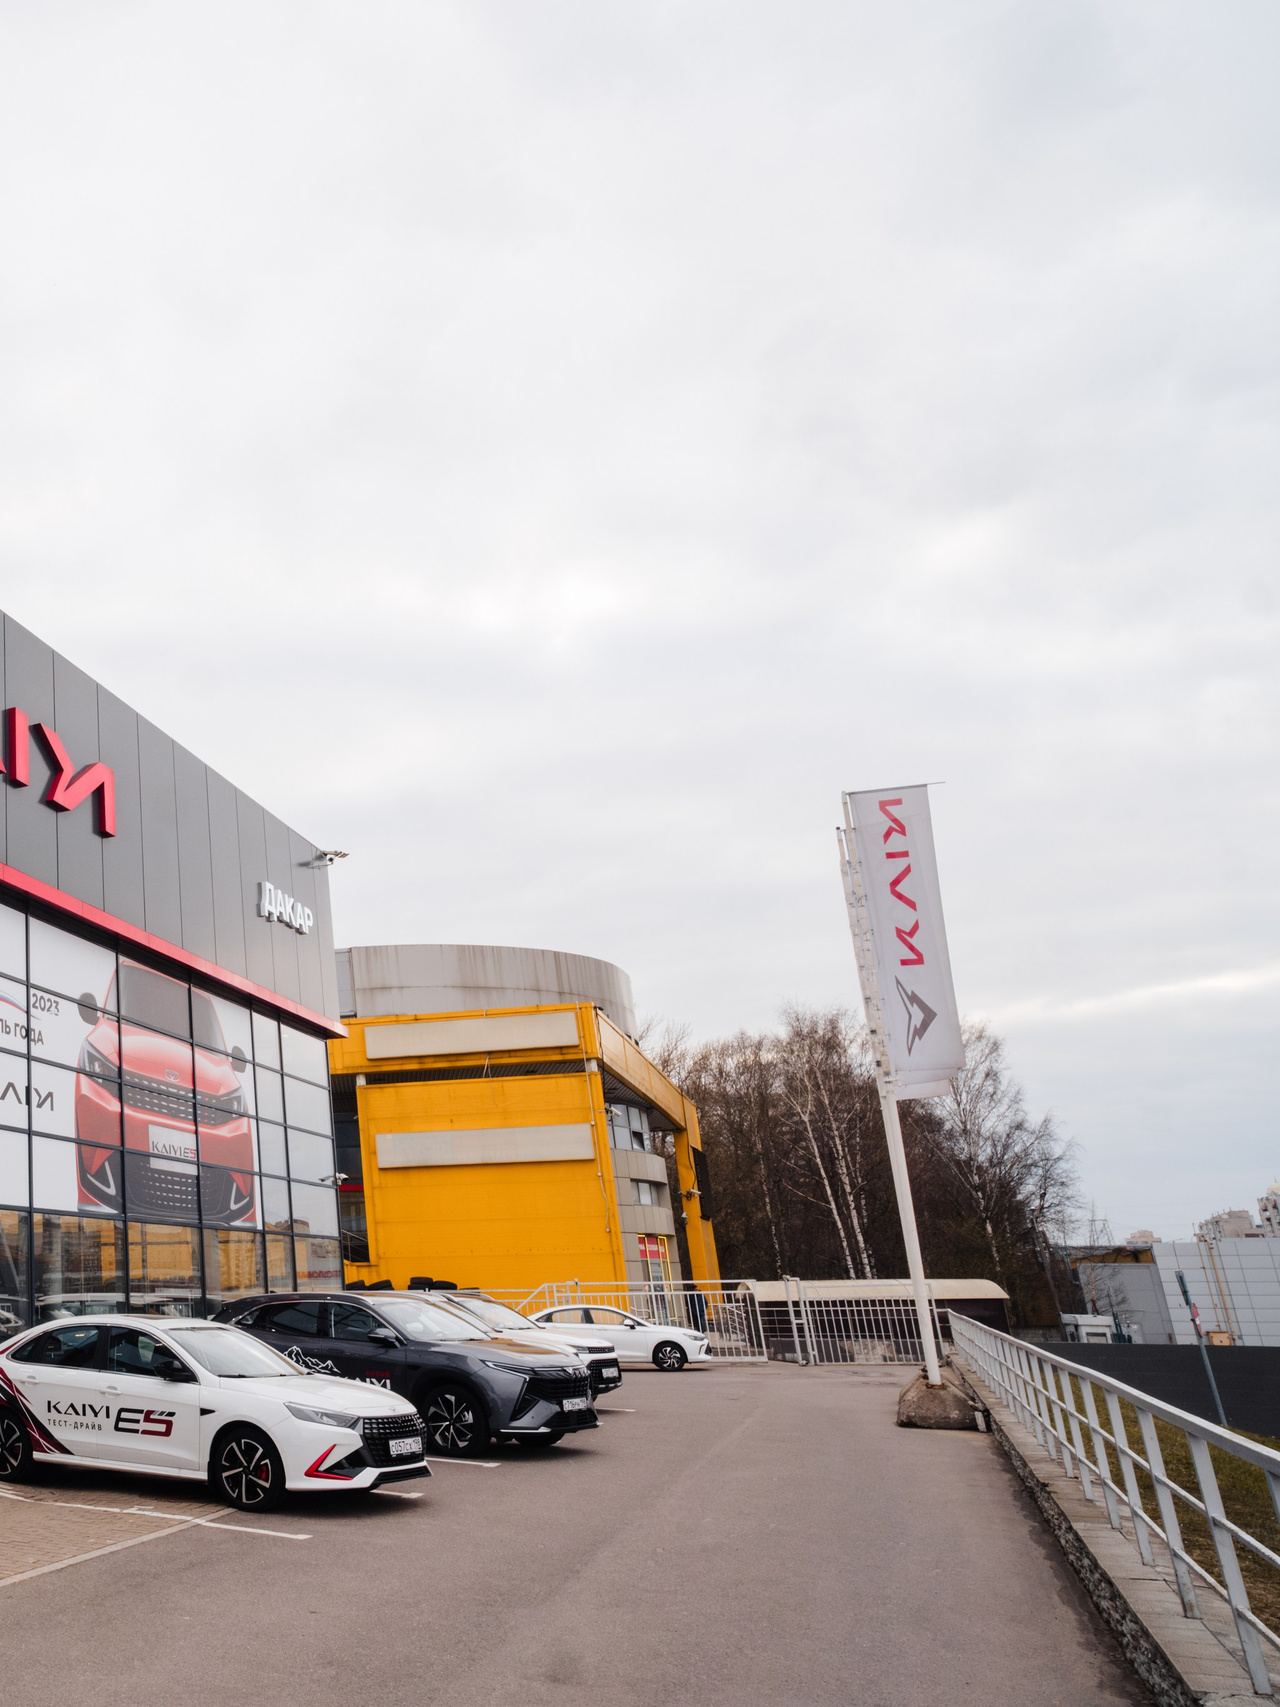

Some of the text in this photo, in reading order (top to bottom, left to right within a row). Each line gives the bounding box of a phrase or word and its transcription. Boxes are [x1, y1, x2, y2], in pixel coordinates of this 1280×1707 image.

[259, 881, 313, 934] ДАКАР
[32, 992, 60, 1016] 2023
[14, 1022, 44, 1046] ГОДА
[151, 1140, 182, 1157] KAIYI
[47, 1400, 110, 1419] KAIYI
[47, 1418, 102, 1431] ТЕСТ-ДРАЙВ
